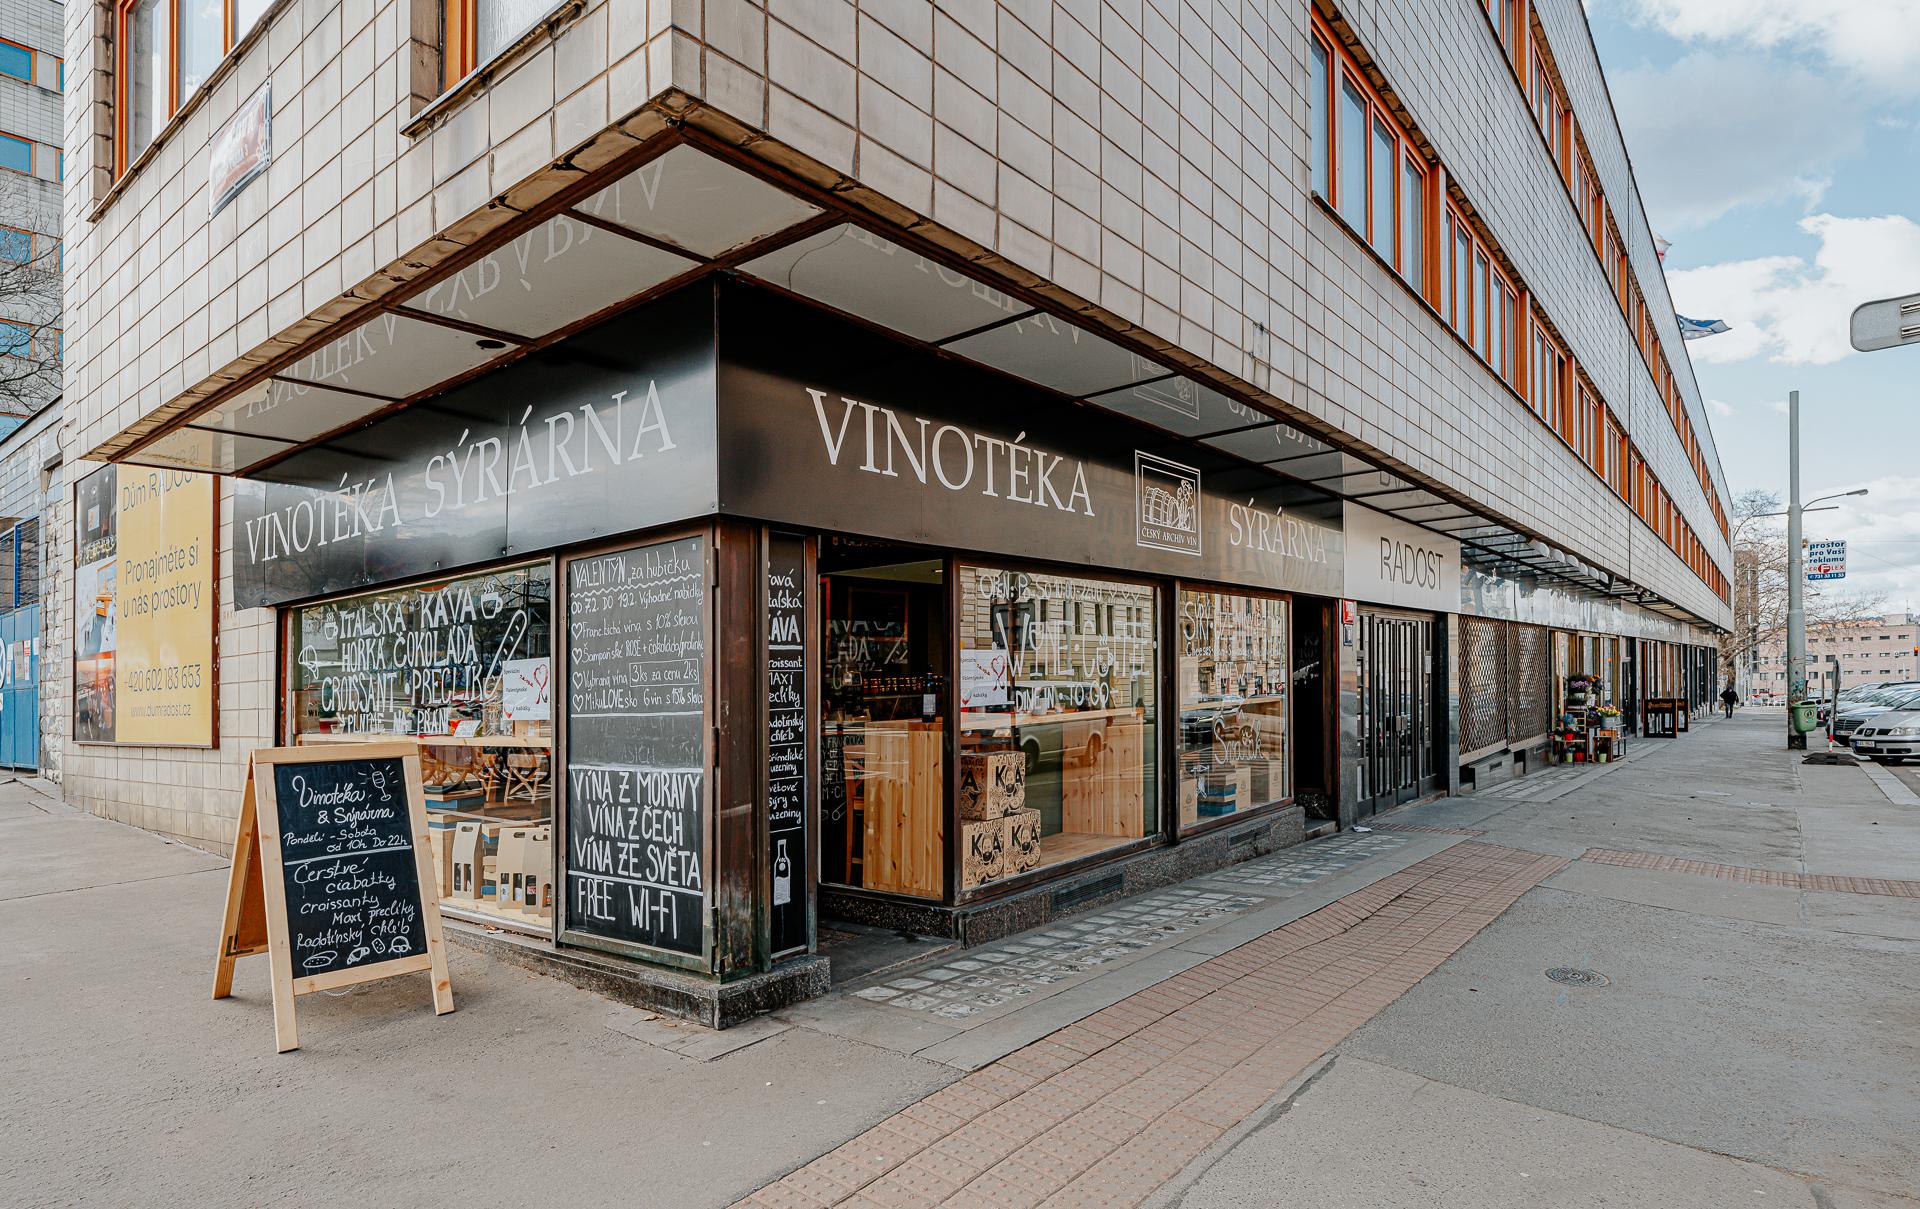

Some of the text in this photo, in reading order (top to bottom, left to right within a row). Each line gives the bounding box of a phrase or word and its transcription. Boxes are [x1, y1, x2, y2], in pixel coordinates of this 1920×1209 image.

[806, 387, 1095, 517] VINOTÉKA
[245, 379, 677, 565] VINOTÉKA SÝRÁRNA
[122, 484, 146, 512] Dům
[1142, 526, 1160, 540] ČESKÝ
[1229, 497, 1327, 564] SÝRÁRNA
[1809, 541, 1845, 550] prostor
[1827, 547, 1844, 555] Vaši
[125, 537, 199, 586] Pronajměte si
[574, 557, 626, 588] VALENTÝN
[1380, 536, 1443, 591] RADOST
[123, 602, 129, 618] u
[131, 592, 149, 617] nás
[151, 580, 202, 619] prostory
[339, 587, 476, 640] ITALSKÁ KÁVA
[571, 601, 582, 615] OD
[603, 596, 613, 610] DO
[618, 593, 637, 607] 19.2.
[656, 610, 671, 630] 10%
[768, 610, 801, 643] ÁVA
[341, 624, 478, 672] HORKÁ ČOKOLÁDA
[768, 655, 802, 669] roissant
[146, 668, 162, 691] 602
[164, 667, 179, 690] 183
[182, 664, 201, 689] 653
[632, 664, 647, 682] 3ks
[652, 670, 661, 681] za
[664, 669, 681, 680] cenu
[683, 660, 698, 681] 2ks
[321, 671, 398, 713] CROISSANT
[585, 688, 638, 710] MikuLOVEsko
[292, 775, 366, 808] Vinotéka
[572, 770, 701, 812] VÍNA Z MORAVY
[792, 794, 799, 802] a
[317, 803, 395, 829] & Sýrárna
[588, 800, 683, 846] VÍNA Z ČECH
[283, 832, 325, 846] Pondělí
[337, 825, 377, 841] Sobota
[327, 834, 408, 853] od 10h Do 22h
[294, 857, 369, 884] Čerstvé
[575, 830, 701, 889] VÍNA ZE SVĚTA
[325, 871, 396, 894] ciabatty
[300, 891, 380, 915] croissanty
[332, 899, 416, 926] Maxi preclíky
[578, 878, 677, 940] FREE WI-FI
[297, 918, 410, 951] Radotínský chléb
